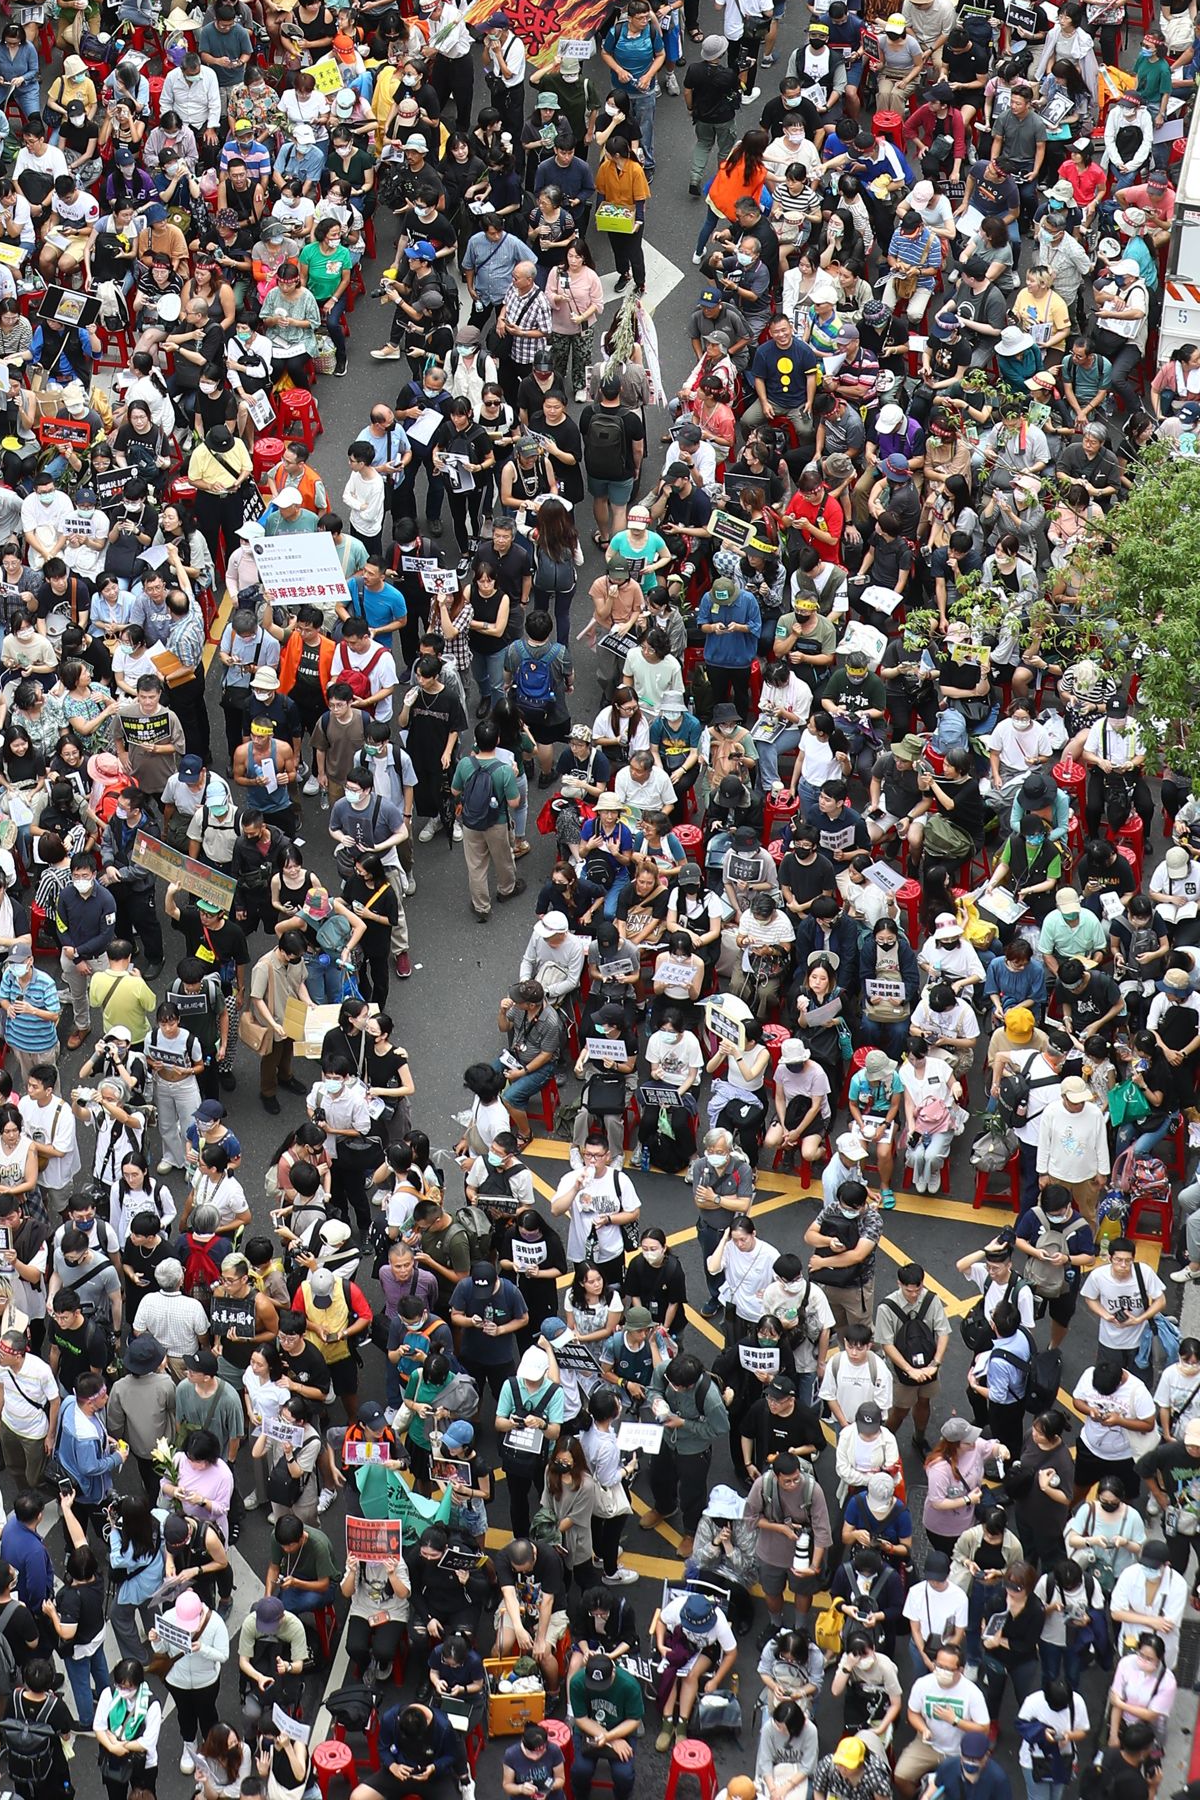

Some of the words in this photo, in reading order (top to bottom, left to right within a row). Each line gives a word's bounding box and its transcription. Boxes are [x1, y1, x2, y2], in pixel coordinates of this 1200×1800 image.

[59, 207, 79, 219] TAIWAN
[1178, 309, 1188, 324] 5
[64, 519, 91, 527] 沒有討論
[869, 982, 901, 991] 沒有討論
[514, 1244, 544, 1254] 沒有討論
[515, 1255, 545, 1265] 不是民主
[211, 1310, 254, 1326] 我藐視國會
[743, 1349, 775, 1359] 沒有討論
[744, 1360, 775, 1370] 不是民主
